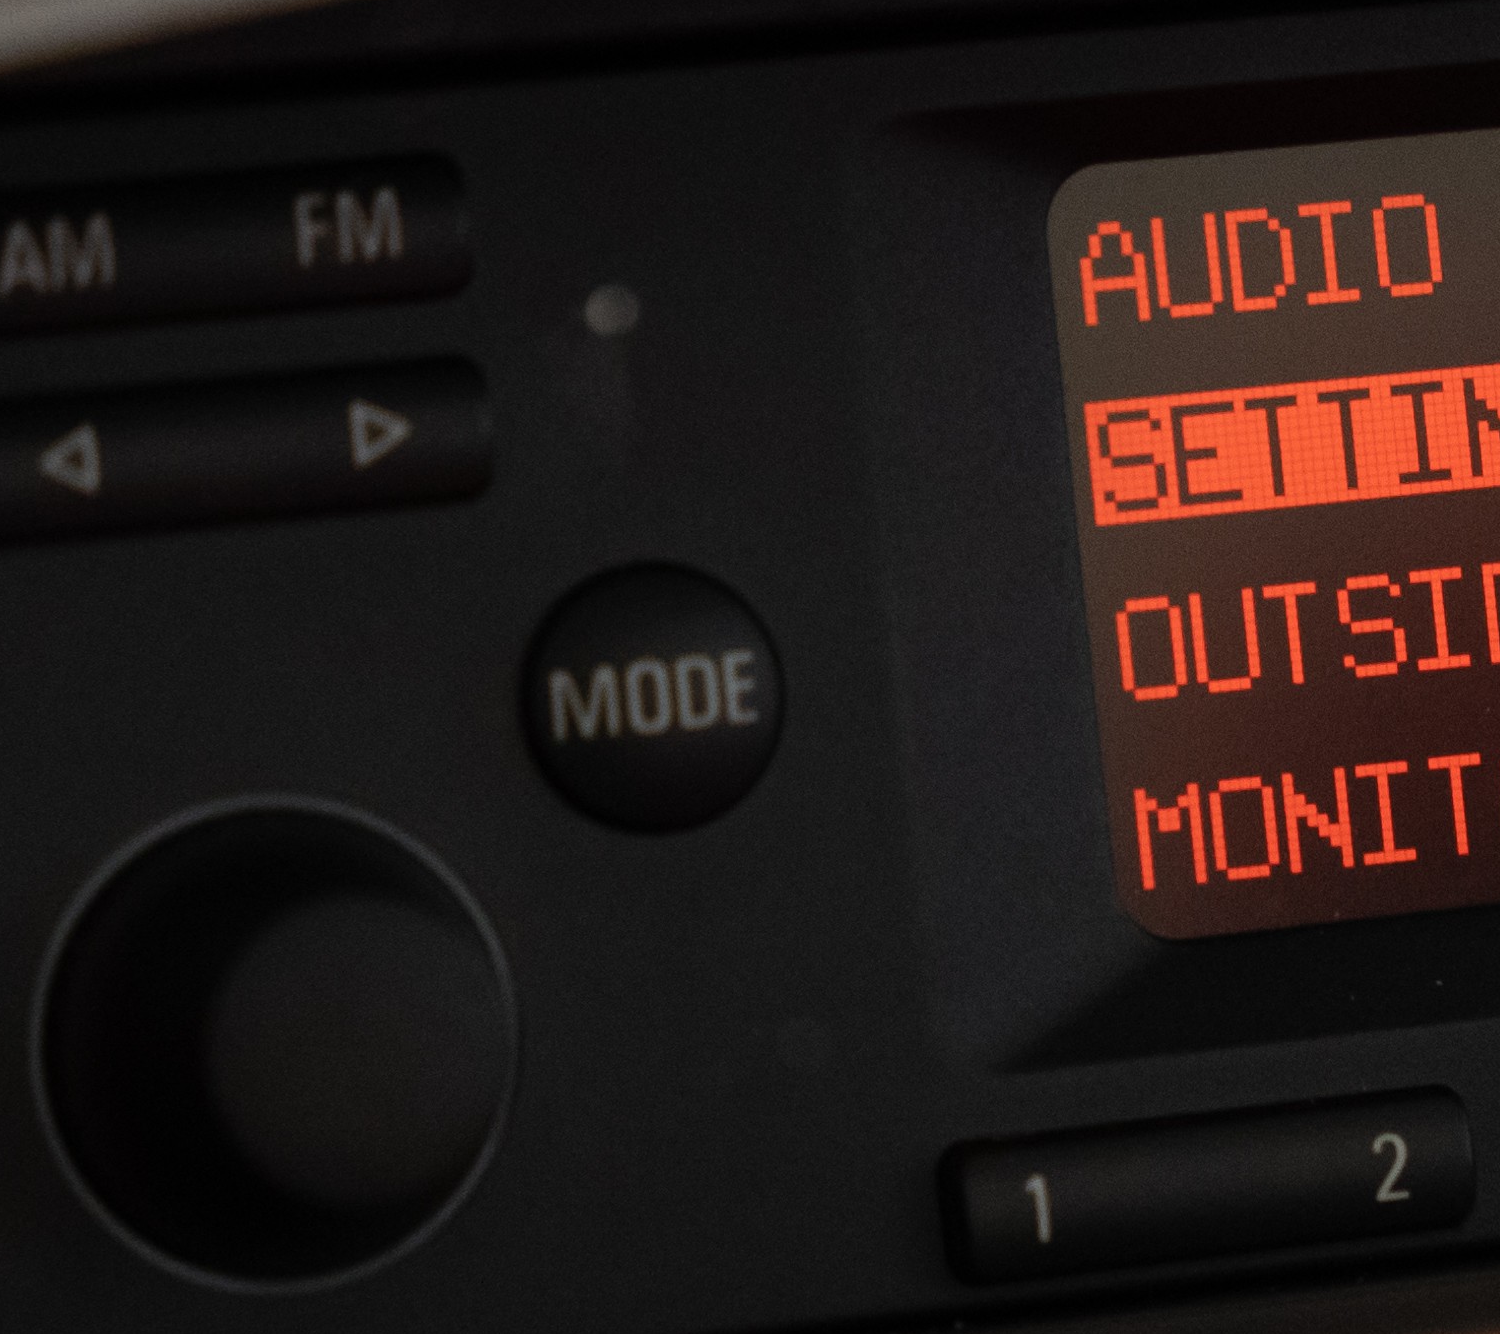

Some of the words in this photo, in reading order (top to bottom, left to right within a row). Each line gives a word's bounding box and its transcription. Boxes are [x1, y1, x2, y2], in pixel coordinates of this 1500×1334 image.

[292, 187, 405, 268] FM
[1079, 193, 1443, 326] AUDIO
[548, 646, 760, 740] MODE
[1022, 1172, 1054, 1244] 1
[1369, 1129, 1412, 1205] 2
